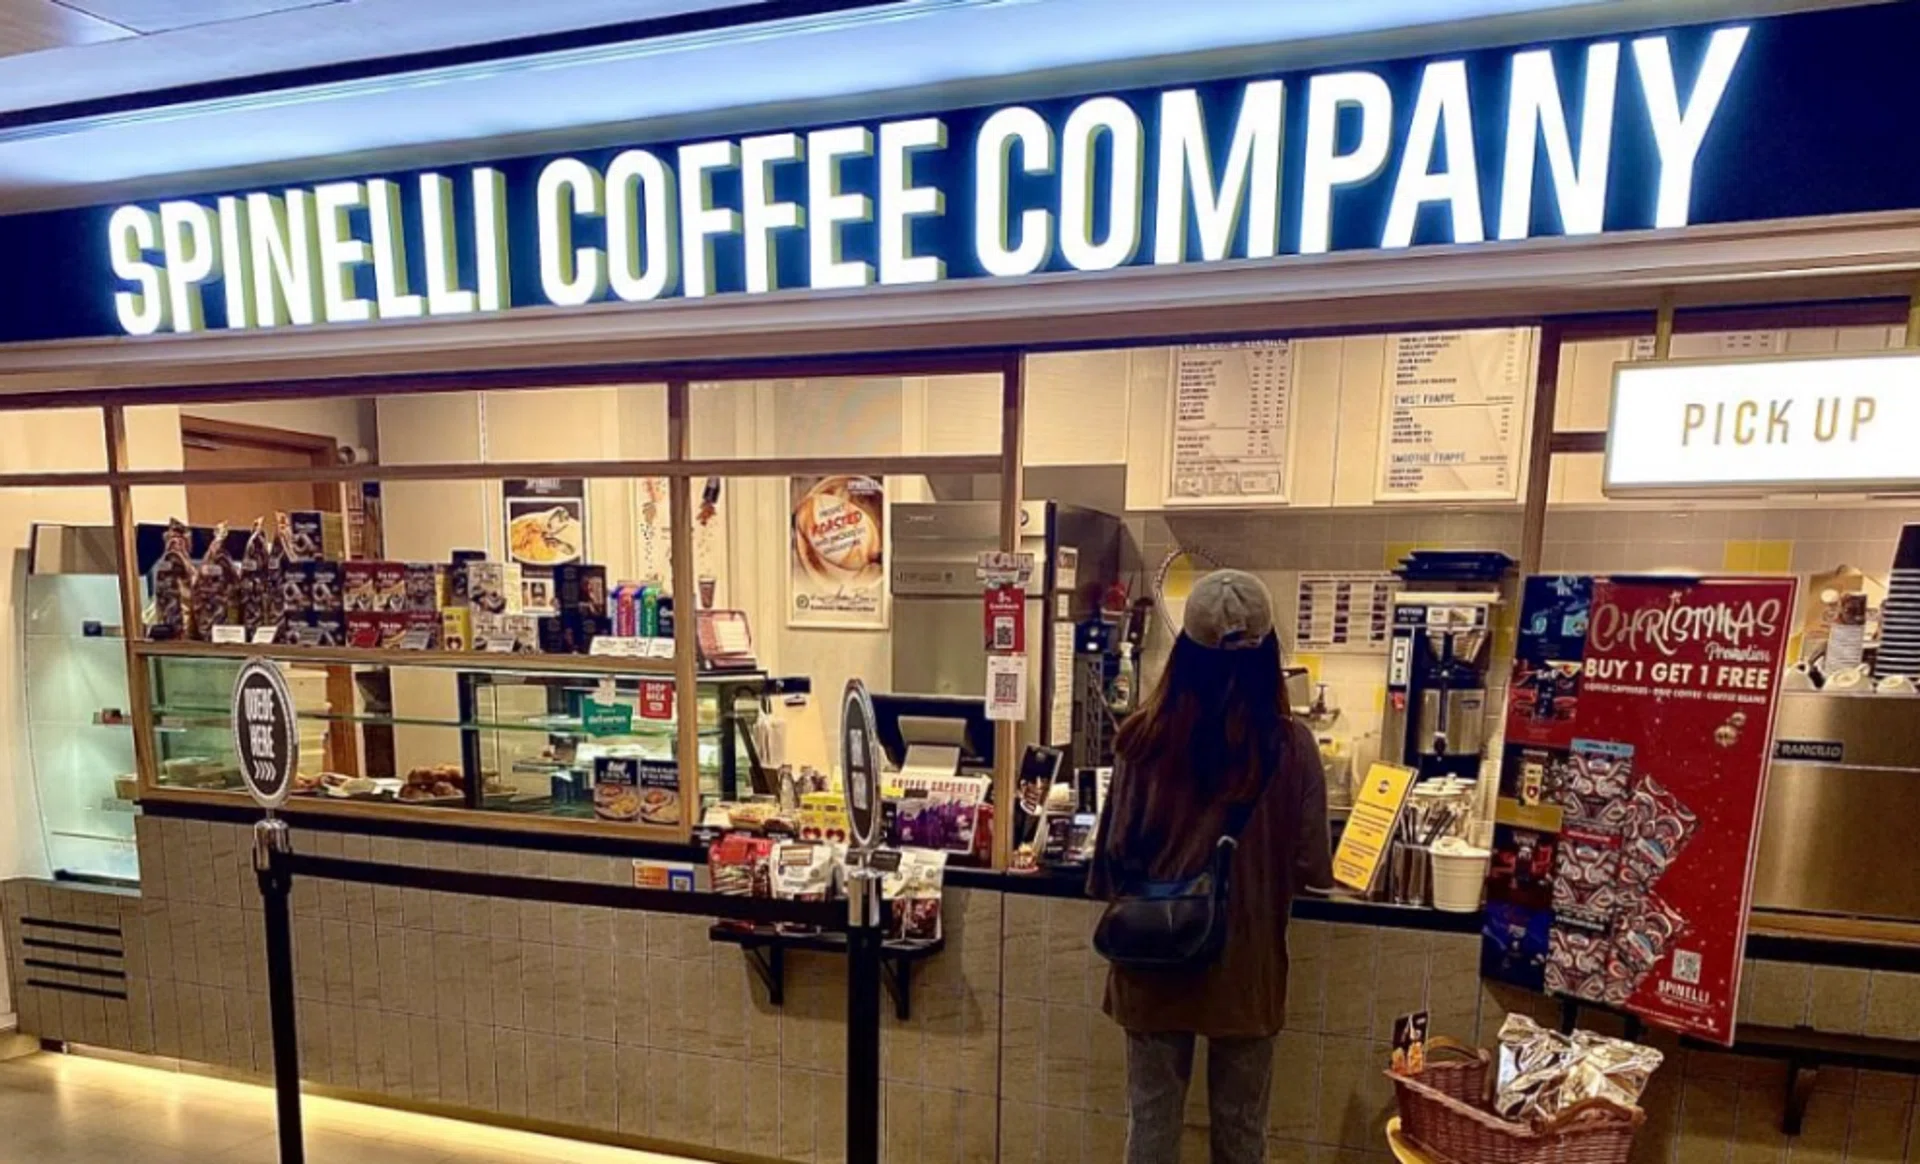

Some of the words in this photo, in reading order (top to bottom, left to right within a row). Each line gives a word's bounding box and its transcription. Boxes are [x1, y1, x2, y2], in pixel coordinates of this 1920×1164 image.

[108, 167, 504, 335] SPINELLI
[537, 118, 944, 306] COFFEE
[976, 26, 1751, 277] COMPANY
[1682, 399, 1793, 446] PICK
[1813, 396, 1877, 442] UP
[1591, 590, 1781, 656] CHRISTMAS
[1585, 657, 1628, 679] BUY
[1635, 660, 1644, 681] 1
[1651, 661, 1693, 685] GET
[1700, 664, 1709, 686] 1
[1717, 665, 1771, 690] FREE
[1782, 744, 1841, 757] RANCILIO
[1657, 979, 1711, 1005] SPINELLI
